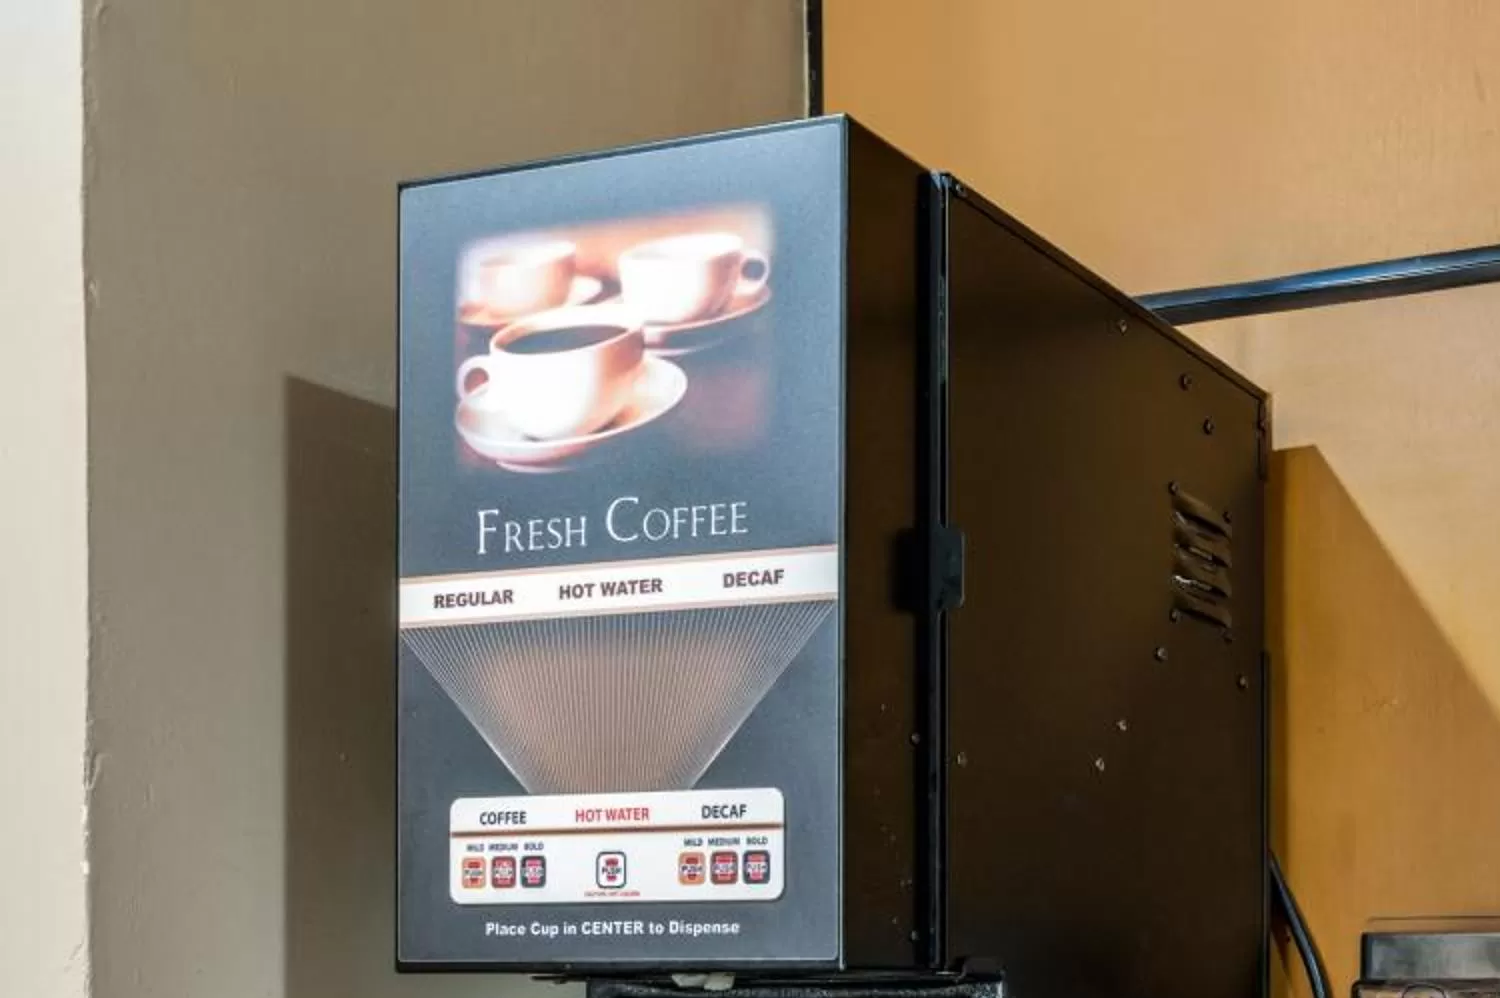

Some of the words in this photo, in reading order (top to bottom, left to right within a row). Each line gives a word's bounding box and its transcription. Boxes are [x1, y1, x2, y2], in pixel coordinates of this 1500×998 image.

[476, 508, 588, 555] FRESH
[605, 496, 749, 542] COFFEE
[722, 568, 785, 588] DECAF
[433, 588, 514, 609] REGULAR
[558, 583, 595, 600] HOT
[600, 578, 663, 596] WATER
[479, 811, 527, 825] COFFEE
[575, 809, 602, 823] HOT
[605, 807, 650, 822] WATER
[701, 803, 748, 819] DECAF
[484, 921, 526, 936] Place
[529, 921, 560, 938] Cup
[563, 921, 578, 935] in
[581, 920, 645, 936] CENTER
[649, 921, 665, 935] to
[669, 919, 741, 937] Dispense
